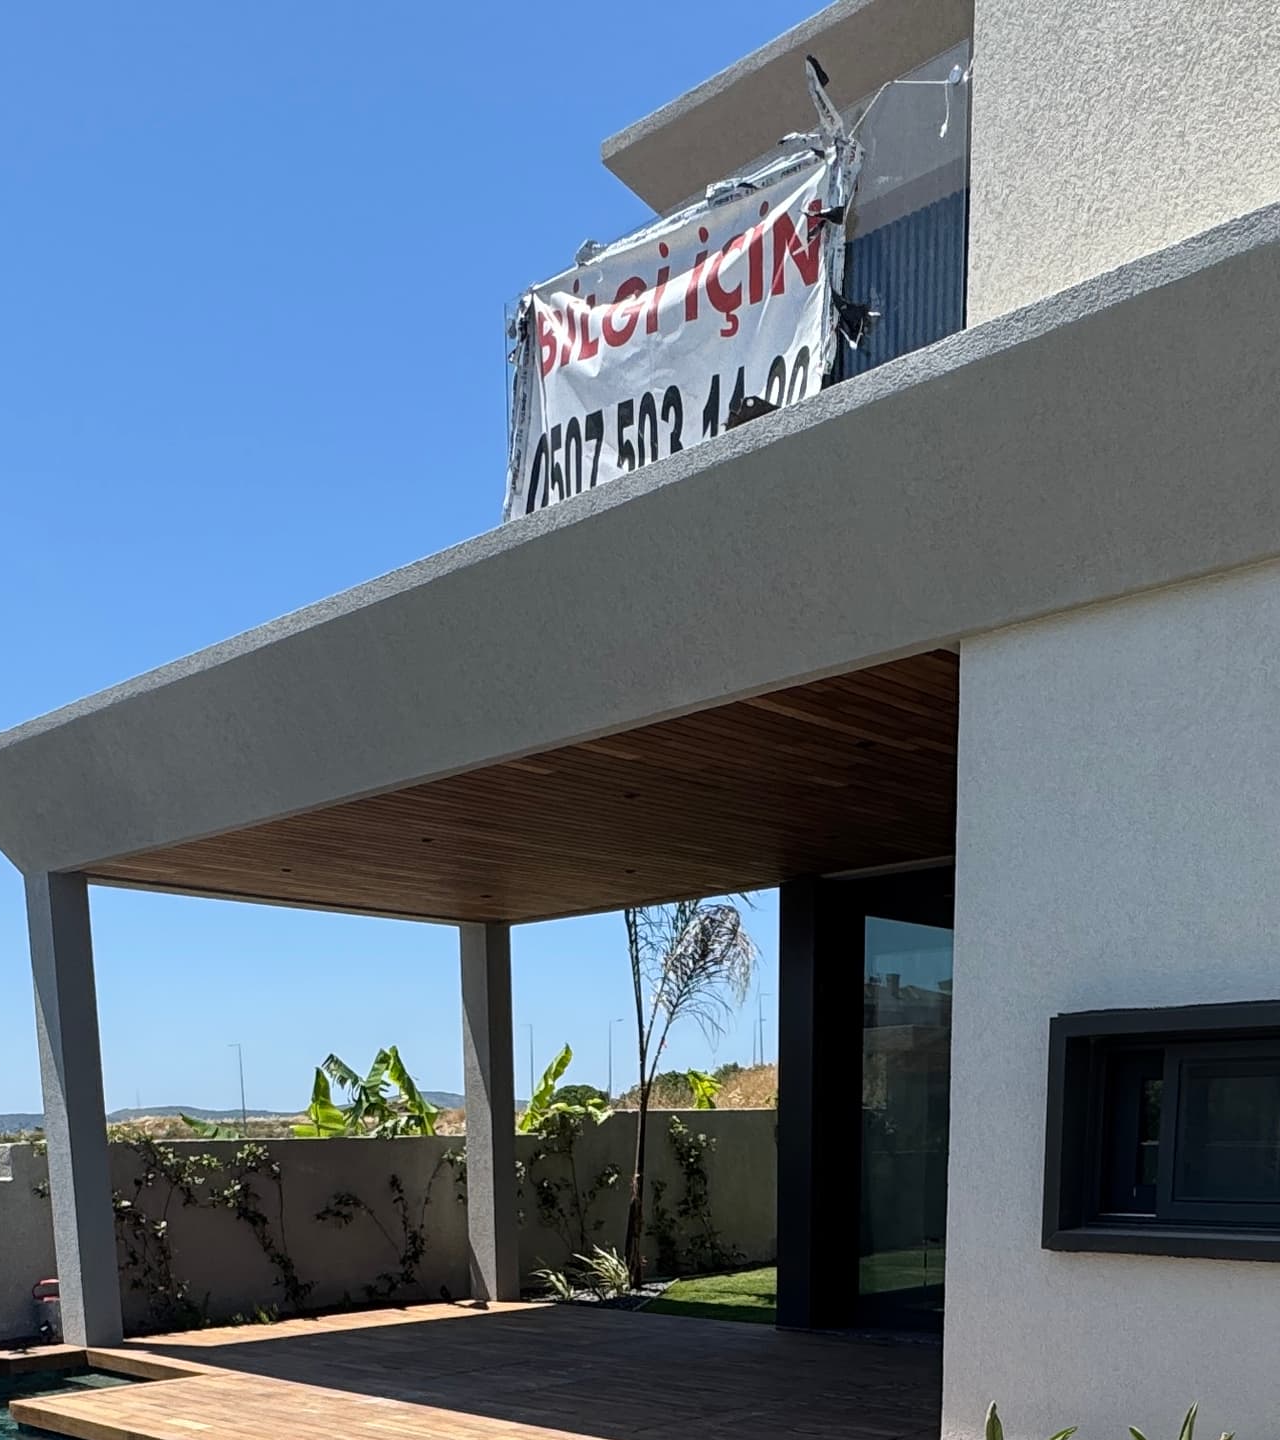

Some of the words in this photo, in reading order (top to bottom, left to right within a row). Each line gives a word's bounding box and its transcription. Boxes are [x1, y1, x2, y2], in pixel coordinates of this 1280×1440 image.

[685, 199, 822, 337] İÇİN
[526, 409, 604, 514] 0507
[617, 385, 683, 472] 503
